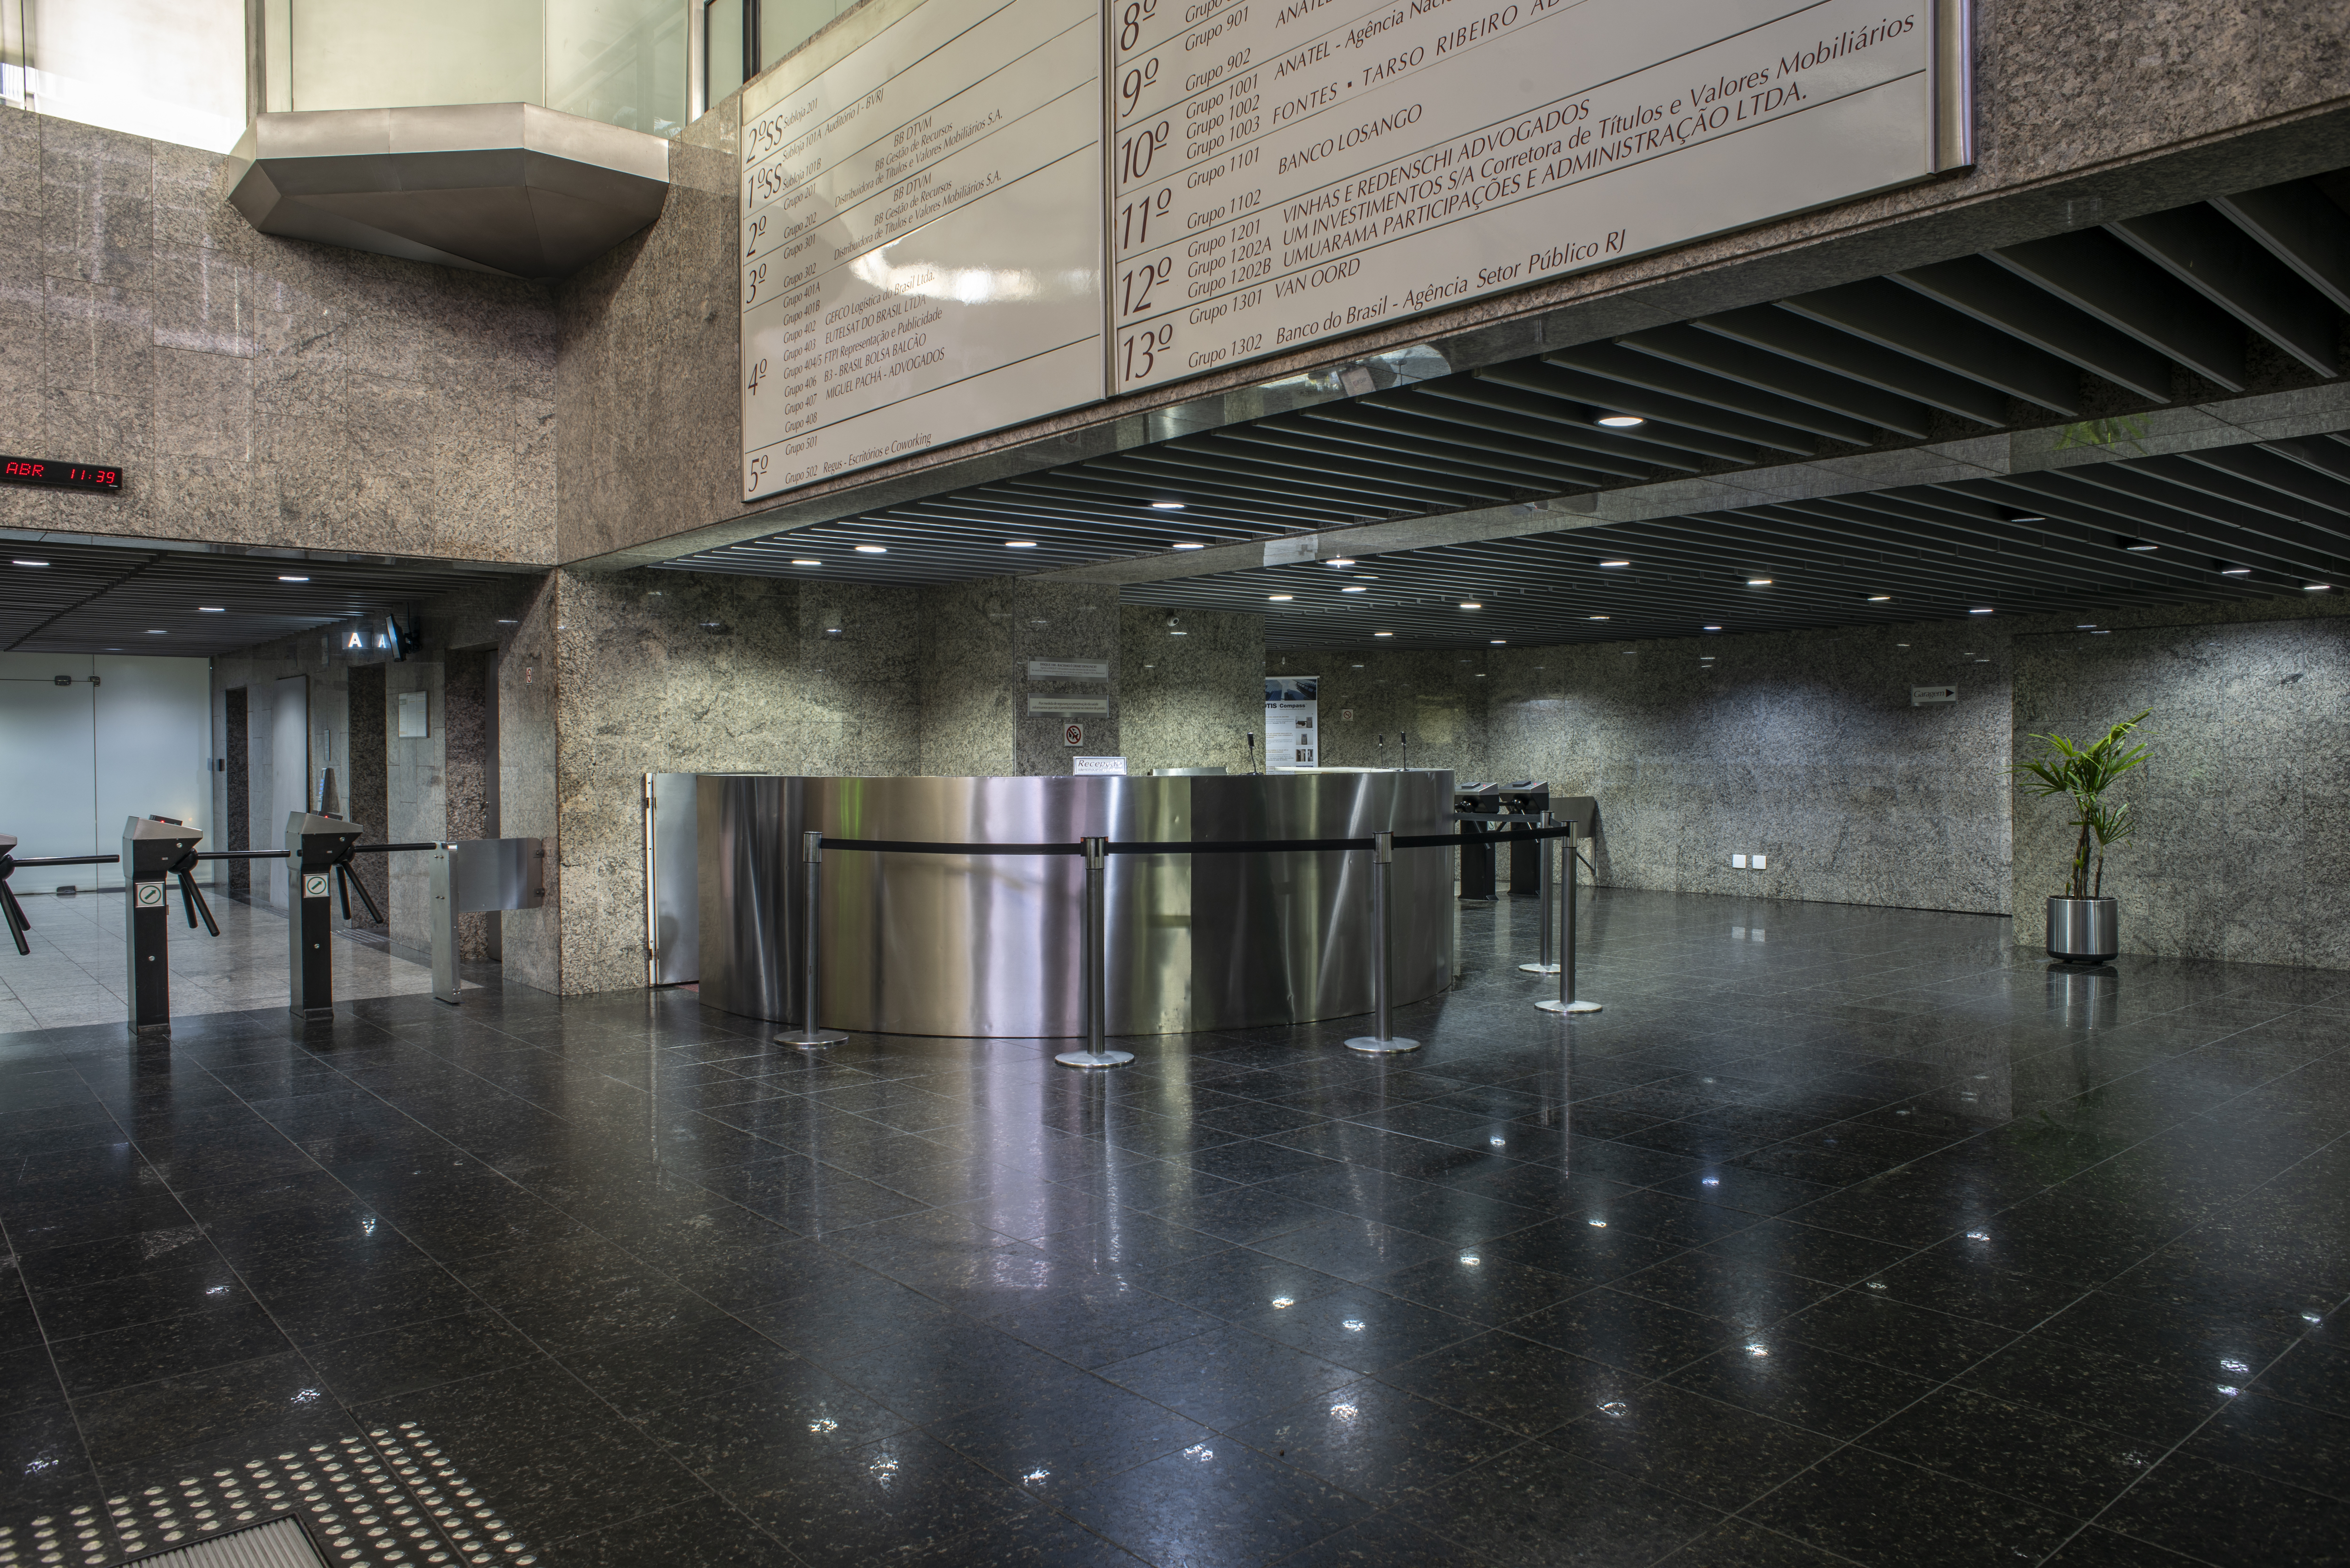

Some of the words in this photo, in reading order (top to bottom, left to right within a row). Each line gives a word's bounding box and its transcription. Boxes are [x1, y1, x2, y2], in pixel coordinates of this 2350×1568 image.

[1275, 0, 1332, 28] ANAT
[1186, 94, 1223, 118] Grupo
[1230, 73, 1257, 100] 1001
[1275, 41, 1330, 80] ANATEL
[1345, 9, 1403, 48] Agência
[1186, 66, 1222, 91] Grupo
[1228, 48, 1250, 72] 902
[1274, 83, 1337, 124] FONTES
[1363, 47, 1424, 86] TARSO
[1436, 6, 1517, 55] RIBEIRO
[783, 141, 804, 162] Subloja
[807, 129, 821, 147] 101A
[825, 109, 855, 135] Auditório
[857, 103, 859, 115] I
[867, 88, 884, 109] BVRJ
[784, 107, 805, 128] Subloja
[807, 98, 817, 114] 201
[894, 132, 904, 147] BB
[907, 116, 931, 140] DTVM
[835, 180, 873, 208] Distribuidora
[876, 173, 884, 185] de
[886, 162, 907, 179] Títulos
[909, 159, 913, 167] e
[916, 144, 941, 164] Valores
[944, 120, 985, 149] Mobiliários
[988, 109, 1002, 125] S.A.
[875, 158, 884, 171] BB
[886, 147, 909, 164] Gestão
[911, 139, 919, 152] de
[921, 123, 952, 147] Recursos
[1188, 257, 1225, 277] Grupo
[1232, 236, 1271, 263] 1202A
[1284, 223, 1308, 245] UM
[1313, 176, 1442, 236] INVESTIMENTOS
[1448, 165, 1474, 190] S/A
[1481, 140, 1561, 181] Corretora
[1569, 126, 1590, 148] de
[1599, 105, 1662, 139] Títulos
[1670, 100, 1681, 115] e
[1691, 69, 1769, 107] Valores
[1777, 15, 1914, 79] Mobiliários
[1279, 139, 1333, 175] BANCO
[1339, 104, 1422, 151] LOSANGO
[1284, 189, 1340, 223] VINHAS
[1345, 184, 1353, 203] E
[1358, 148, 1452, 198] REDENSCHI
[1457, 99, 1590, 163] ADVOGADOS
[1187, 207, 1225, 228] Grupo
[1231, 189, 1261, 213] 1102
[1188, 277, 1225, 298] Grupo
[1232, 257, 1271, 284] 1202B
[1284, 222, 1377, 267] UMUARAMA
[1384, 174, 1520, 235] PARTICIPAÇÕES
[1527, 168, 1537, 189] E
[1542, 106, 1729, 184] ADMINISTRAÇÃO
[1737, 82, 1806, 121] LTDA.
[784, 223, 803, 238] Grupo
[805, 212, 816, 227] 202
[783, 293, 802, 308] Grupo
[804, 282, 820, 298] 401A
[784, 273, 803, 288] Grupo
[805, 263, 816, 278] 302
[1189, 349, 1226, 367] Grupo
[1232, 334, 1261, 356] 1302
[1277, 322, 1319, 344] Banco
[1324, 311, 1341, 330] do
[1347, 295, 1387, 324] Brasil
[1403, 276, 1467, 311] Agência
[1477, 263, 1521, 288] Setor
[1528, 242, 1598, 273] Público
[1606, 229, 1625, 253] RJ
[1276, 274, 1307, 298] VAN
[1311, 258, 1360, 287] OORD
[784, 329, 802, 343] Grupo
[804, 320, 815, 334] 402
[826, 305, 849, 325] GEFCO
[852, 294, 880, 315] Logística
[883, 288, 892, 301] do
[895, 275, 915, 296] Brasil
[917, 270, 934, 286] Ltda.
[784, 347, 802, 361] Grupo
[805, 339, 815, 352] 403
[826, 320, 860, 344] EUTELSAT
[862, 314, 874, 329] DO
[877, 304, 901, 323] BRASIL
[905, 294, 925, 312] LTDA
[784, 366, 802, 379] Grupo
[805, 354, 822, 370] 404/5
[824, 348, 838, 364] FTPI
[840, 330, 889, 358] Representação
[891, 329, 895, 337] e
[898, 307, 942, 335] Publicidade
[824, 369, 832, 382] B3
[839, 358, 862, 376] BRASIL
[866, 347, 890, 367] BOLSA
[893, 334, 926, 356] BALCÃO
[826, 381, 853, 400] MIGUEL
[855, 370, 881, 389] PACHÁ
[889, 347, 944, 378] ADVOGADOS
[6, 462, 44, 476] ABR
[71, 469, 115, 484] 11:39
[786, 472, 804, 484] Grupo
[806, 465, 817, 478] 502
[823, 460, 842, 475] Regus
[849, 447, 883, 466] Escritórios
[885, 446, 889, 455] e
[891, 433, 932, 453] Coworking
[348, 633, 362, 647] A
[1078, 760, 1122, 768] Recepção
